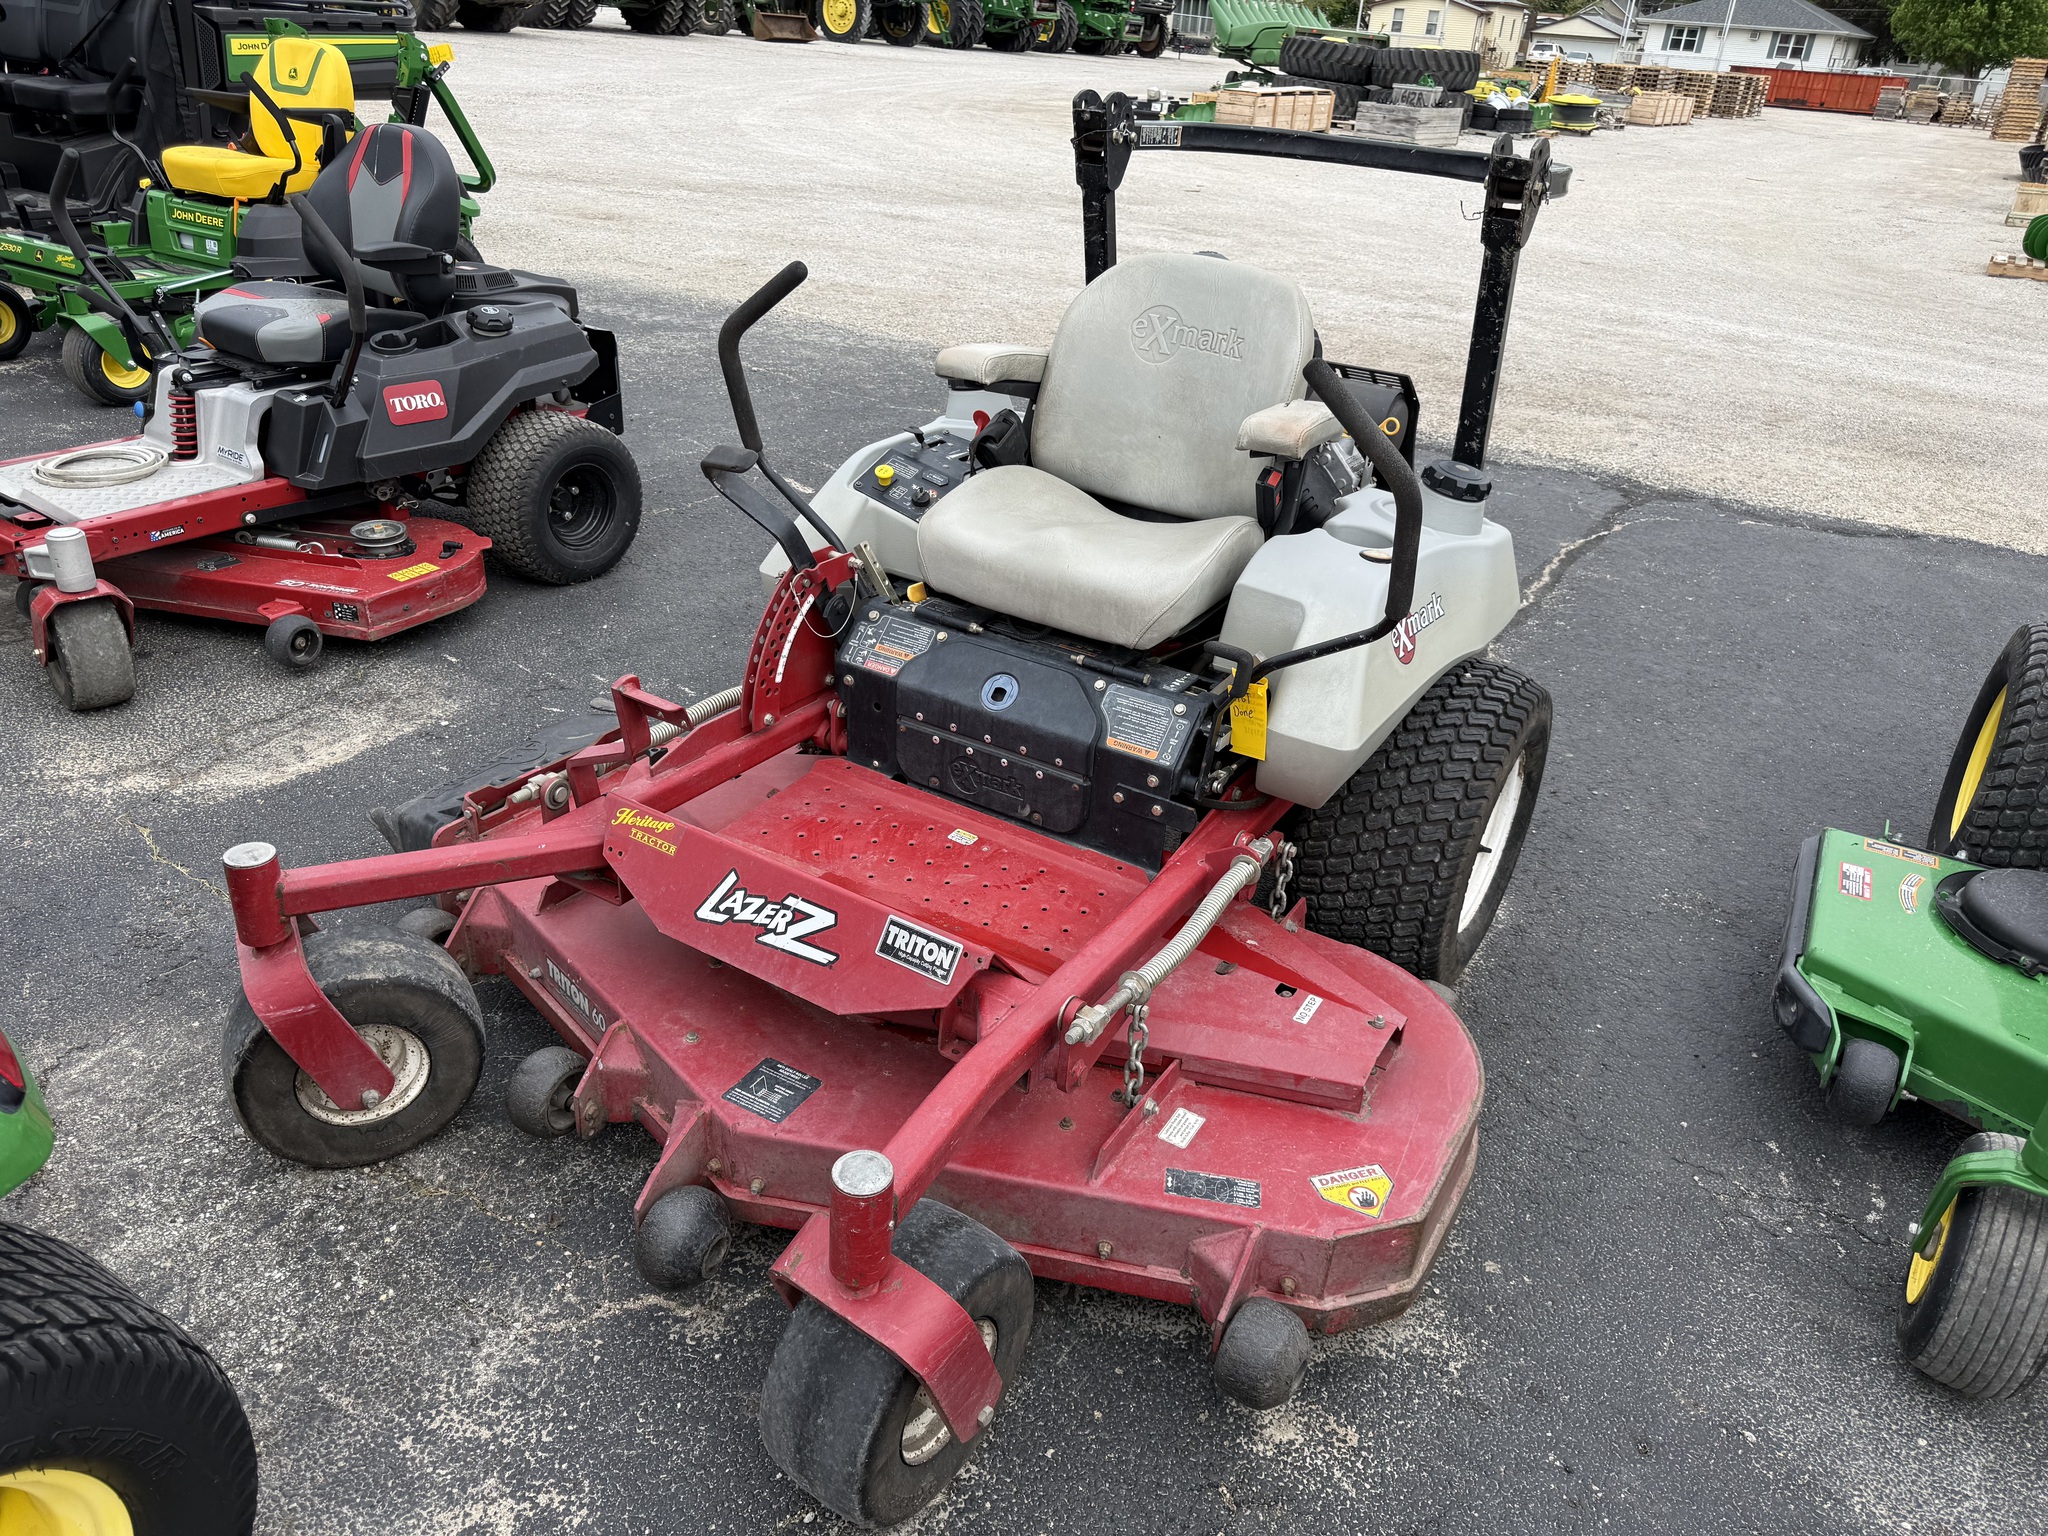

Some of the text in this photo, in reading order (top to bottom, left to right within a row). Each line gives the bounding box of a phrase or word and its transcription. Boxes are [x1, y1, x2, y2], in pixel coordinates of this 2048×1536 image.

[237, 42, 260, 51] JOHN
[172, 207, 224, 228] JOHN DEERE
[1131, 312, 1245, 360] eXmark
[389, 391, 441, 413] TORO
[1391, 592, 1445, 660] eXmark
[1233, 705, 1253, 718] Done
[1113, 740, 1142, 754] WARNING
[611, 808, 676, 833] Heritage
[630, 829, 677, 855] TRACTOR
[695, 868, 840, 967] LAZER Z
[886, 924, 954, 970] TRITON
[546, 957, 606, 1032] TRITON 60
[1295, 996, 1317, 1022] NO STEP
[1317, 1168, 1378, 1187] DANGER
